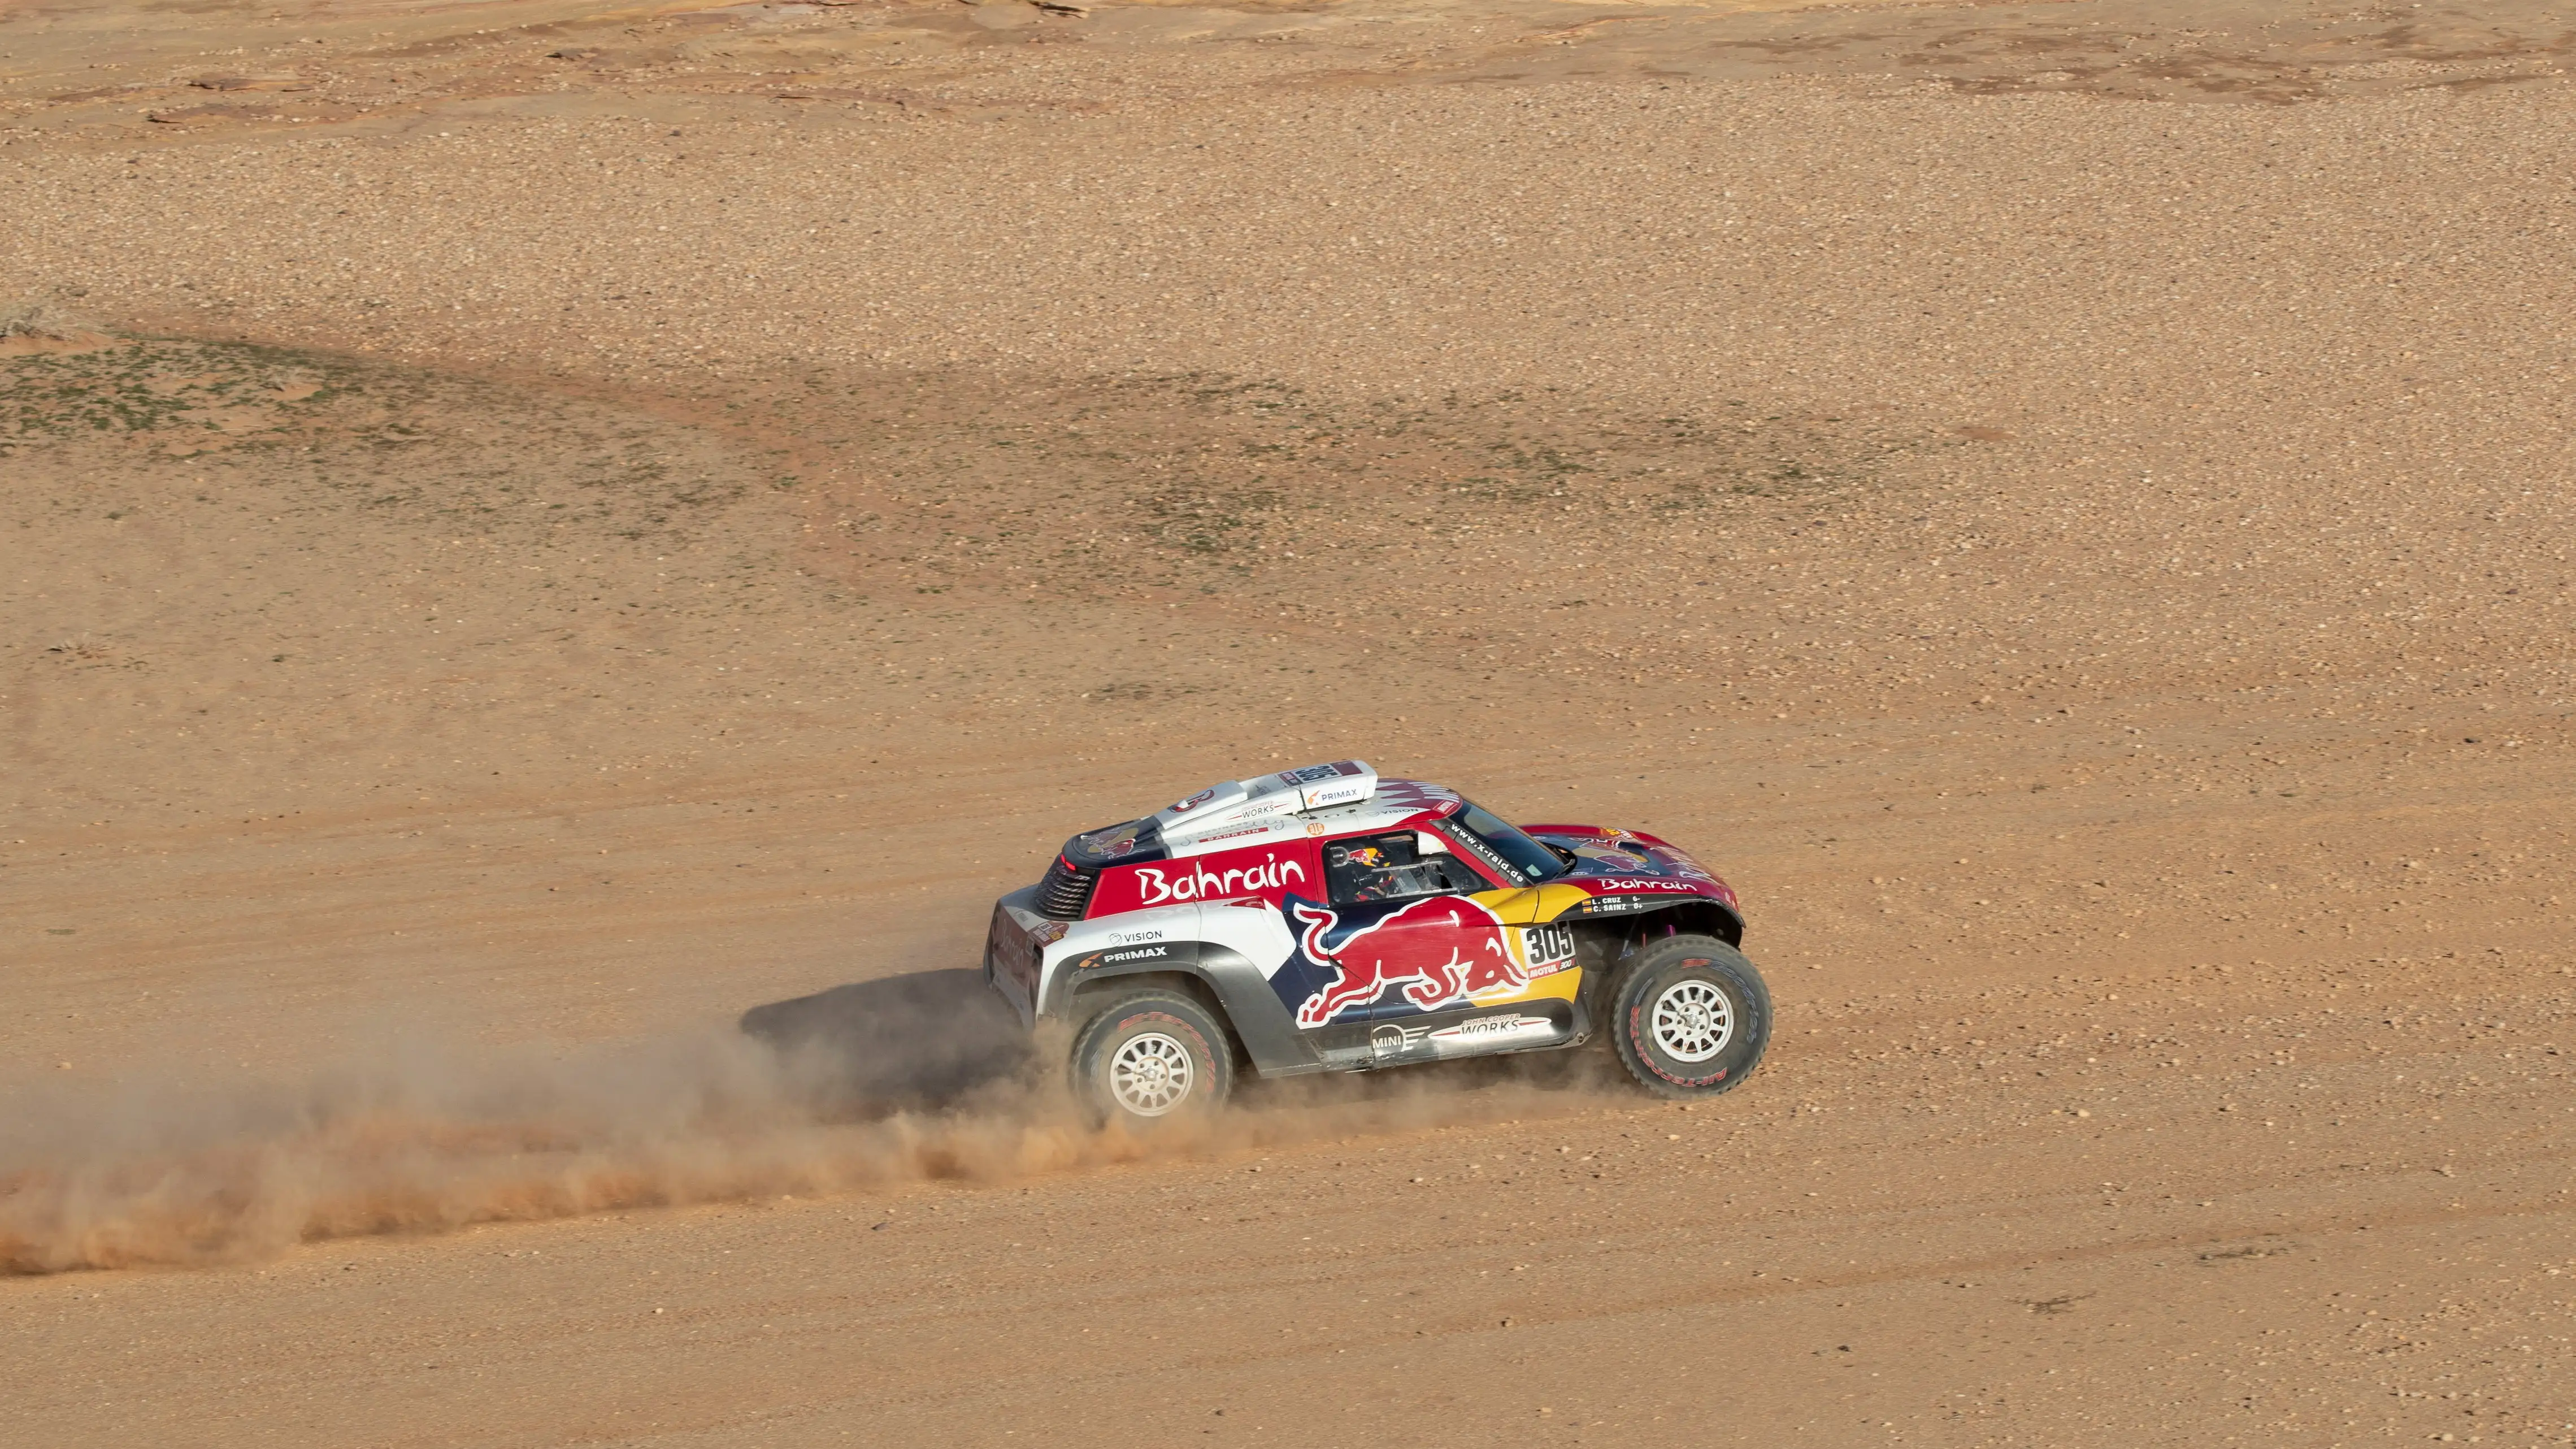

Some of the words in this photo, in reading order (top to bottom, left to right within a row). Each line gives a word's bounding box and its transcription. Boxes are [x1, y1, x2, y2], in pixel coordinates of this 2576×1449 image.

[1322, 789, 1357, 801] PRIMAX
[1242, 804, 1274, 818] WORKS
[1207, 828, 1259, 842] BAHRAIN
[1450, 823, 1524, 883] www.x-raid.de
[1134, 853, 1305, 905] Bahrain
[1597, 878, 1698, 891] Bahrain
[1124, 930, 1162, 942] VISION
[1526, 923, 1572, 964] 305
[1104, 946, 1167, 962] PRIMAX
[1530, 964, 1558, 978] MOTUL
[1462, 1020, 1519, 1035] WORKS
[1372, 1035, 1401, 1049] MINI
